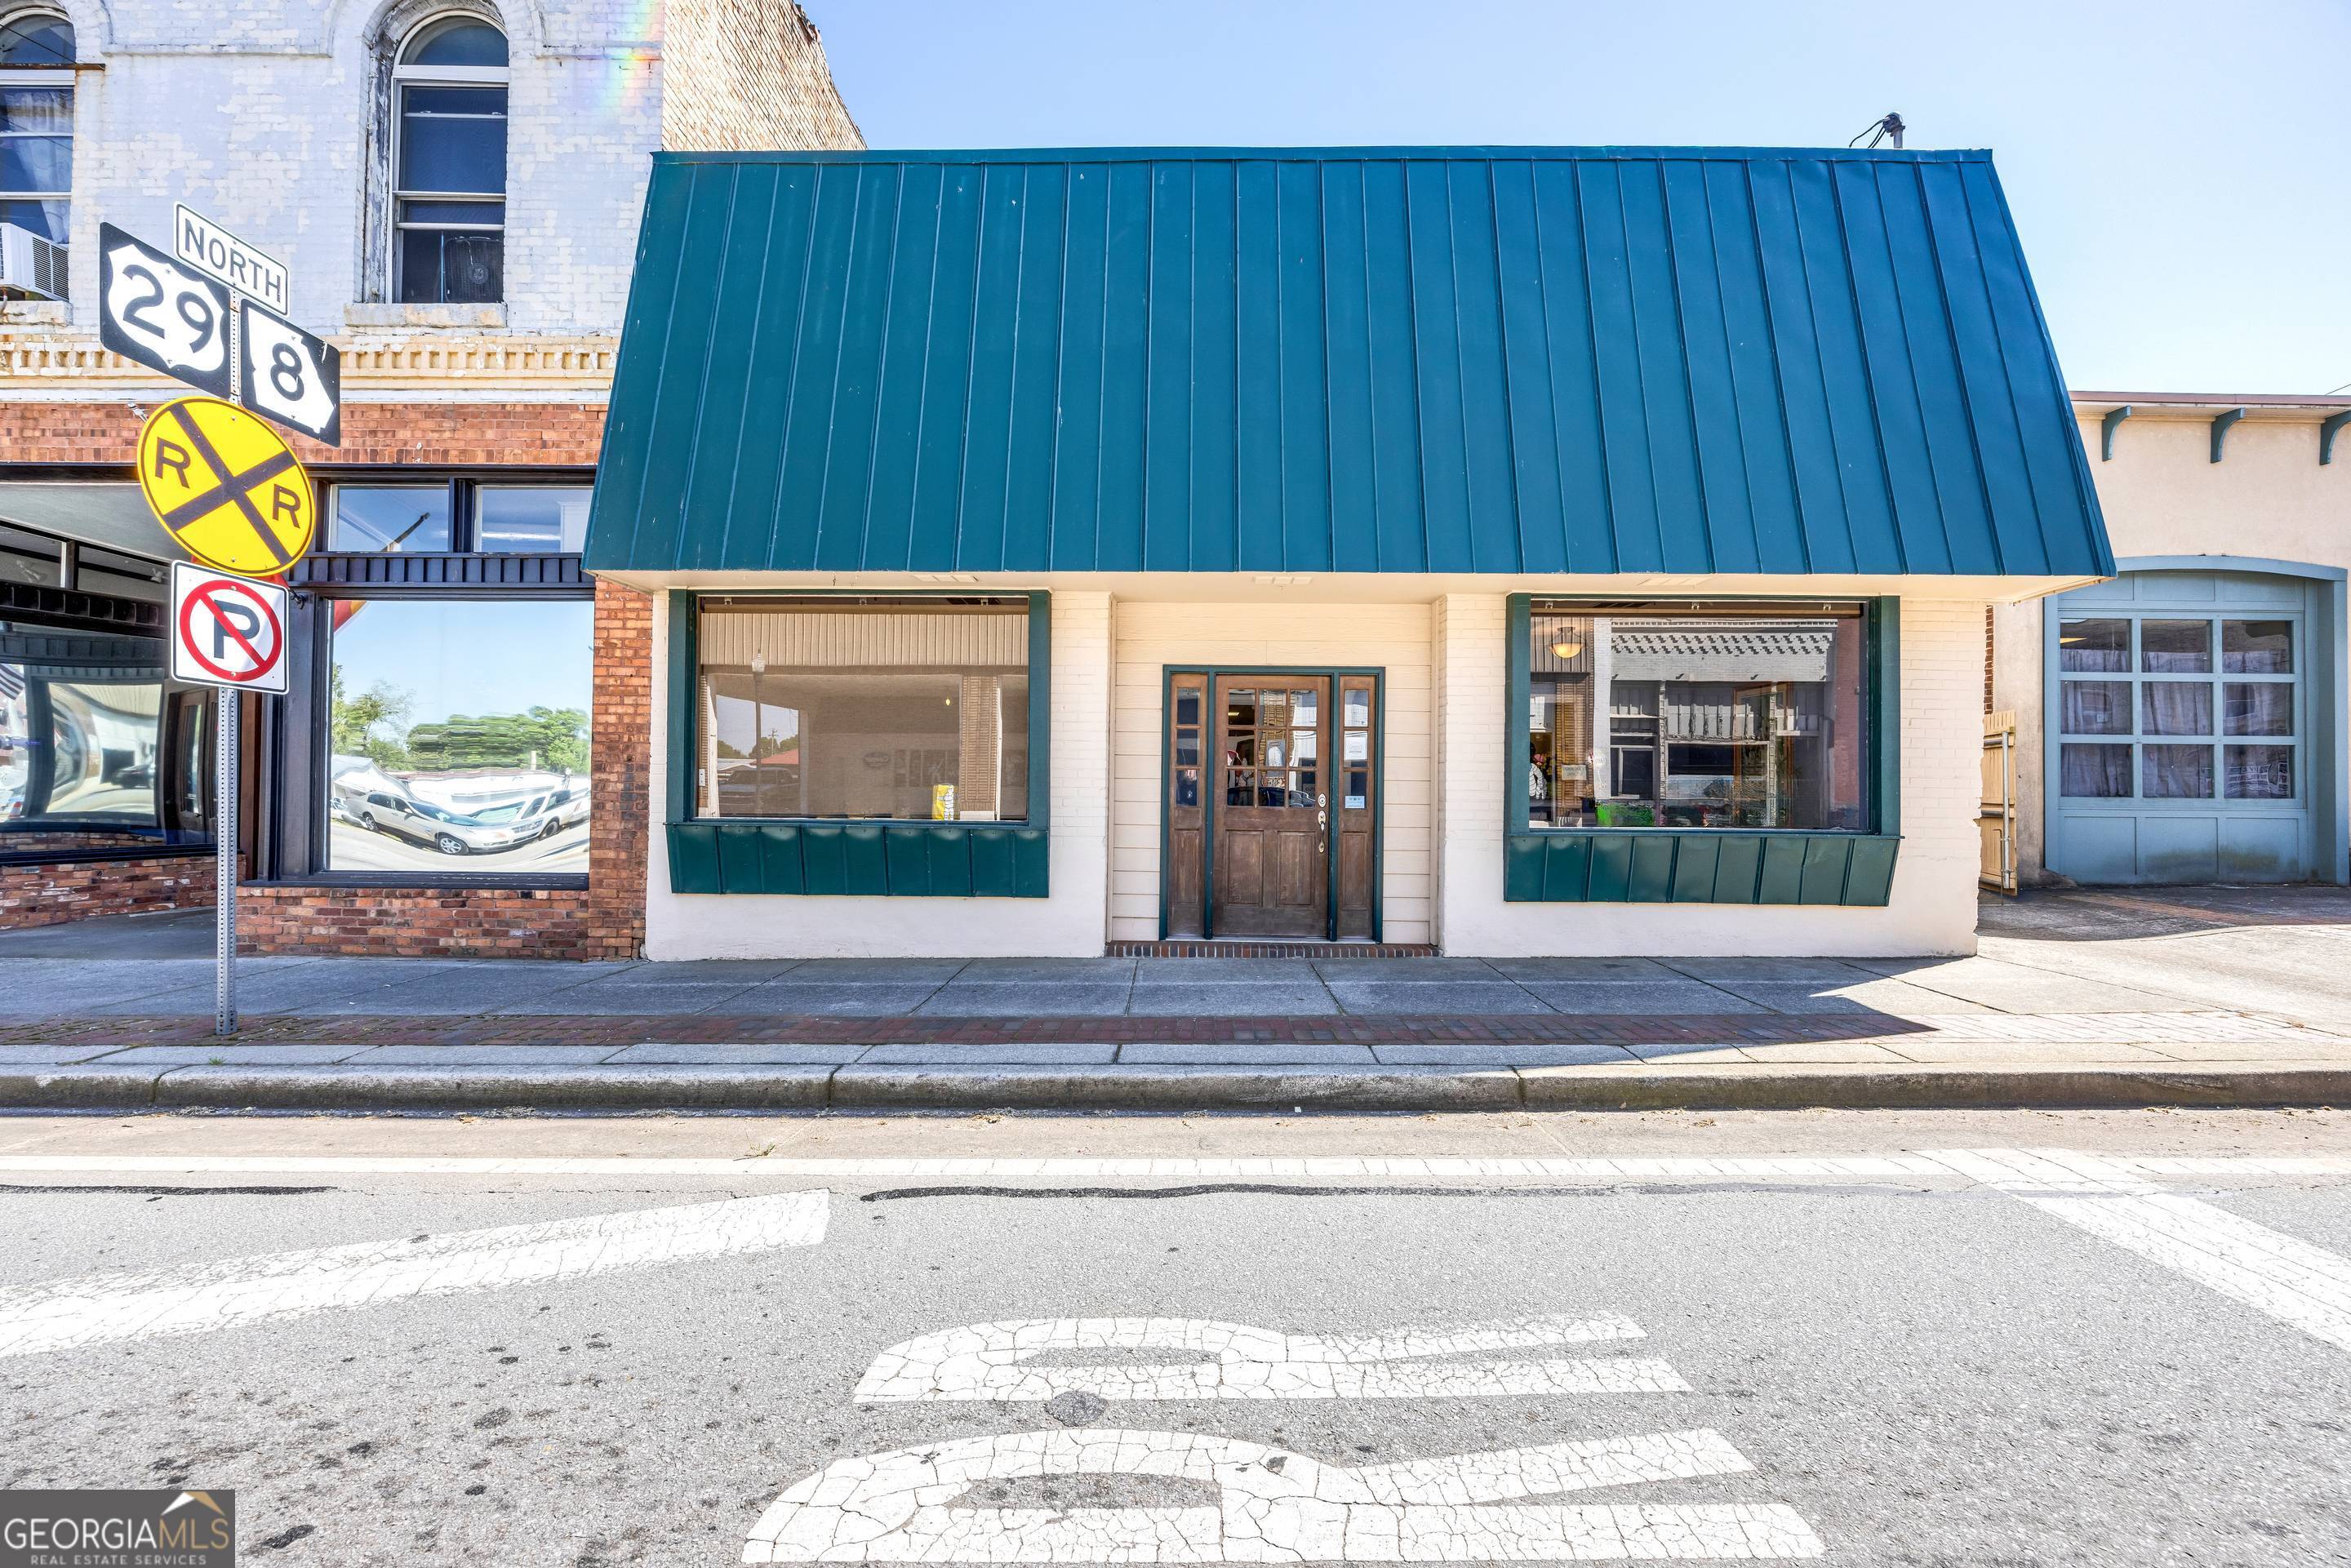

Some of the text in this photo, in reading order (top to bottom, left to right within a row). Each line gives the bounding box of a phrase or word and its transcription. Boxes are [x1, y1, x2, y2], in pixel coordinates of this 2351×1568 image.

[184, 217, 282, 304] NORTH
[122, 264, 215, 353] 29
[270, 342, 305, 402] 8
[154, 436, 301, 529] R R
[213, 599, 261, 660] P
